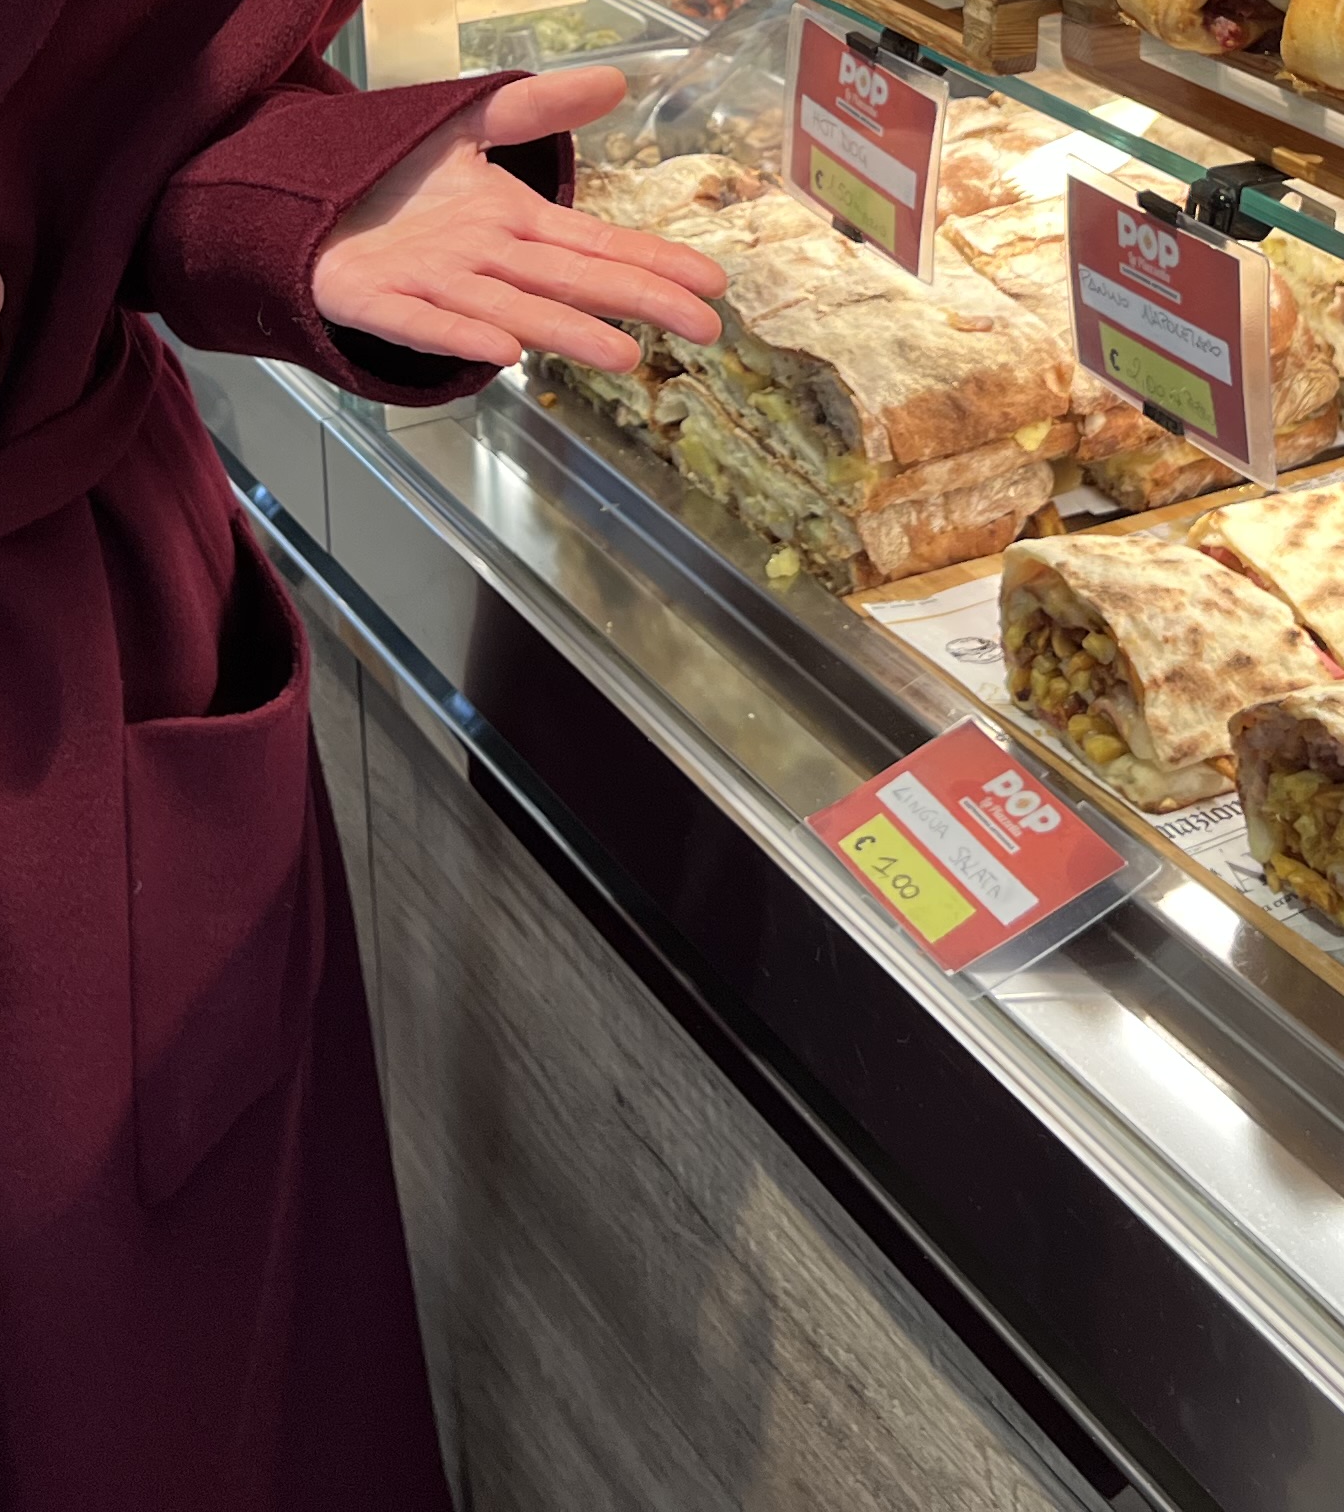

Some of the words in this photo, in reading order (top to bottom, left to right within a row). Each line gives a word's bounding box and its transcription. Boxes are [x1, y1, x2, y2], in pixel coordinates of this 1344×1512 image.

[839, 52, 889, 105] POP
[1117, 210, 1180, 269] POP
[982, 769, 1061, 833] POP
[892, 786, 950, 839] LINGUA
[949, 846, 1002, 899] SALATA
